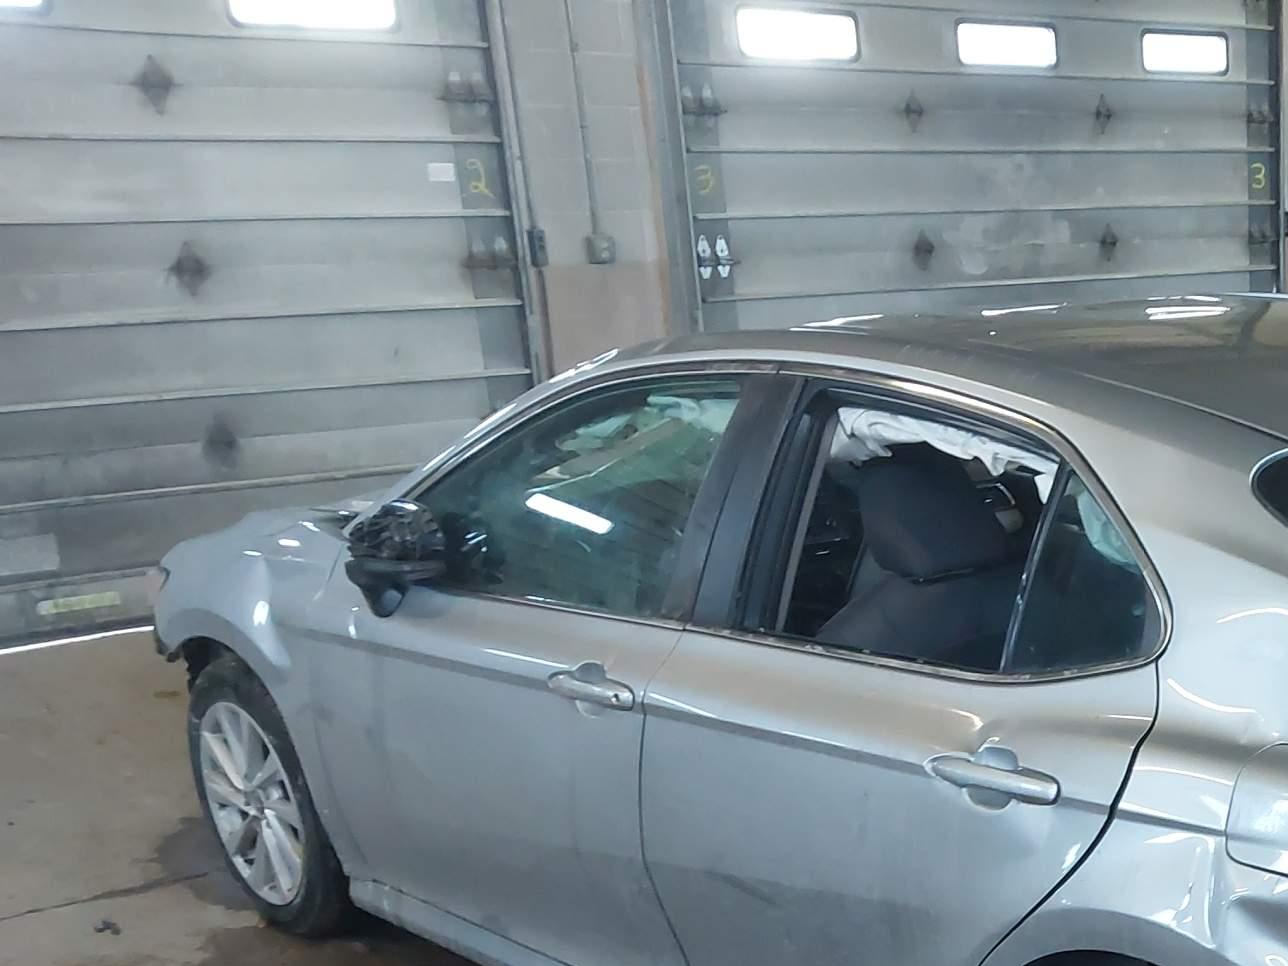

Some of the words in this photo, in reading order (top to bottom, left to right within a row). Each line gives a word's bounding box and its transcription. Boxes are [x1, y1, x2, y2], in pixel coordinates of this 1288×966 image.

[466, 159, 495, 198] 2
[694, 165, 713, 193] 3
[1250, 162, 1265, 189] 3
